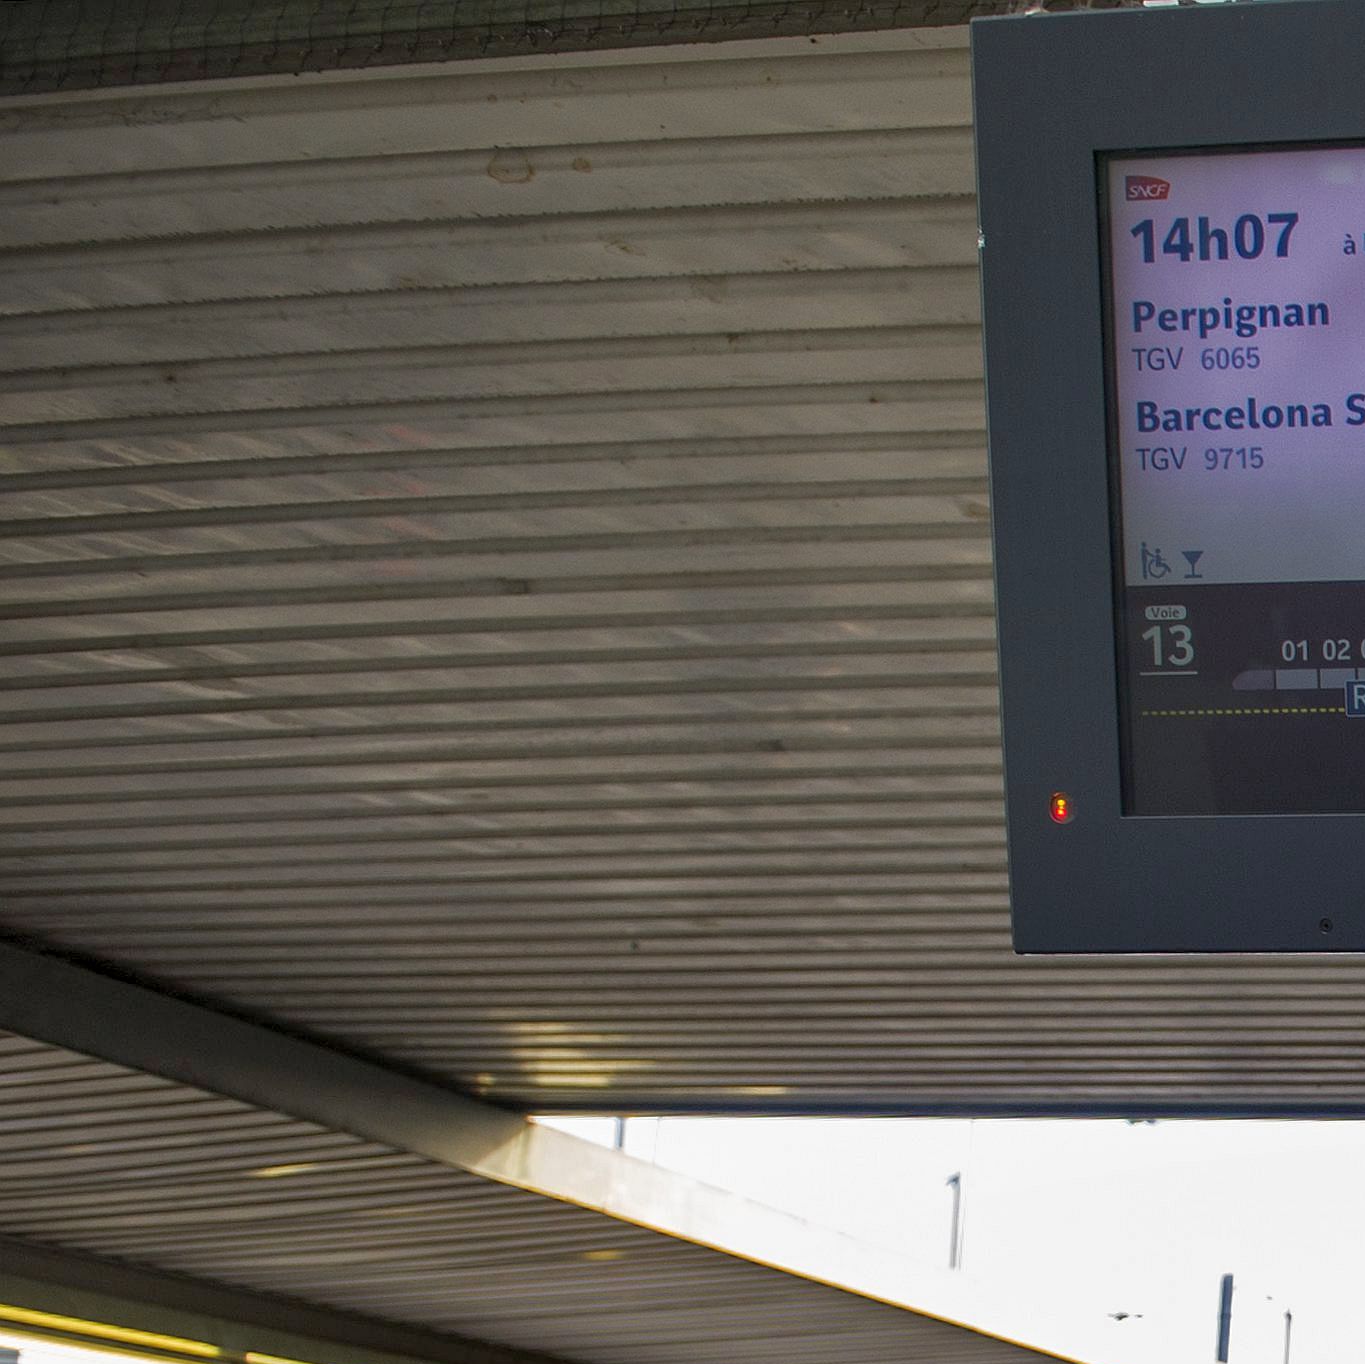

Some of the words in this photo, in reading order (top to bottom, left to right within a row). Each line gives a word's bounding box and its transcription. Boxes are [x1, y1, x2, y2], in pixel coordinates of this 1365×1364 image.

[1127, 184, 1168, 198] SNCF
[1130, 212, 1299, 263] 14h07
[1343, 234, 1357, 255] à
[1132, 298, 1330, 338] Perpignan
[1131, 347, 1184, 372] TGV
[1201, 346, 1261, 370] 6065
[1135, 397, 1333, 433] Barcelona
[1135, 447, 1188, 471] TGV
[1204, 446, 1264, 471] 9715
[1150, 607, 1181, 618] Voie
[1142, 624, 1195, 666] 13
[1281, 640, 1309, 661] 01
[1322, 639, 1351, 661] 02
